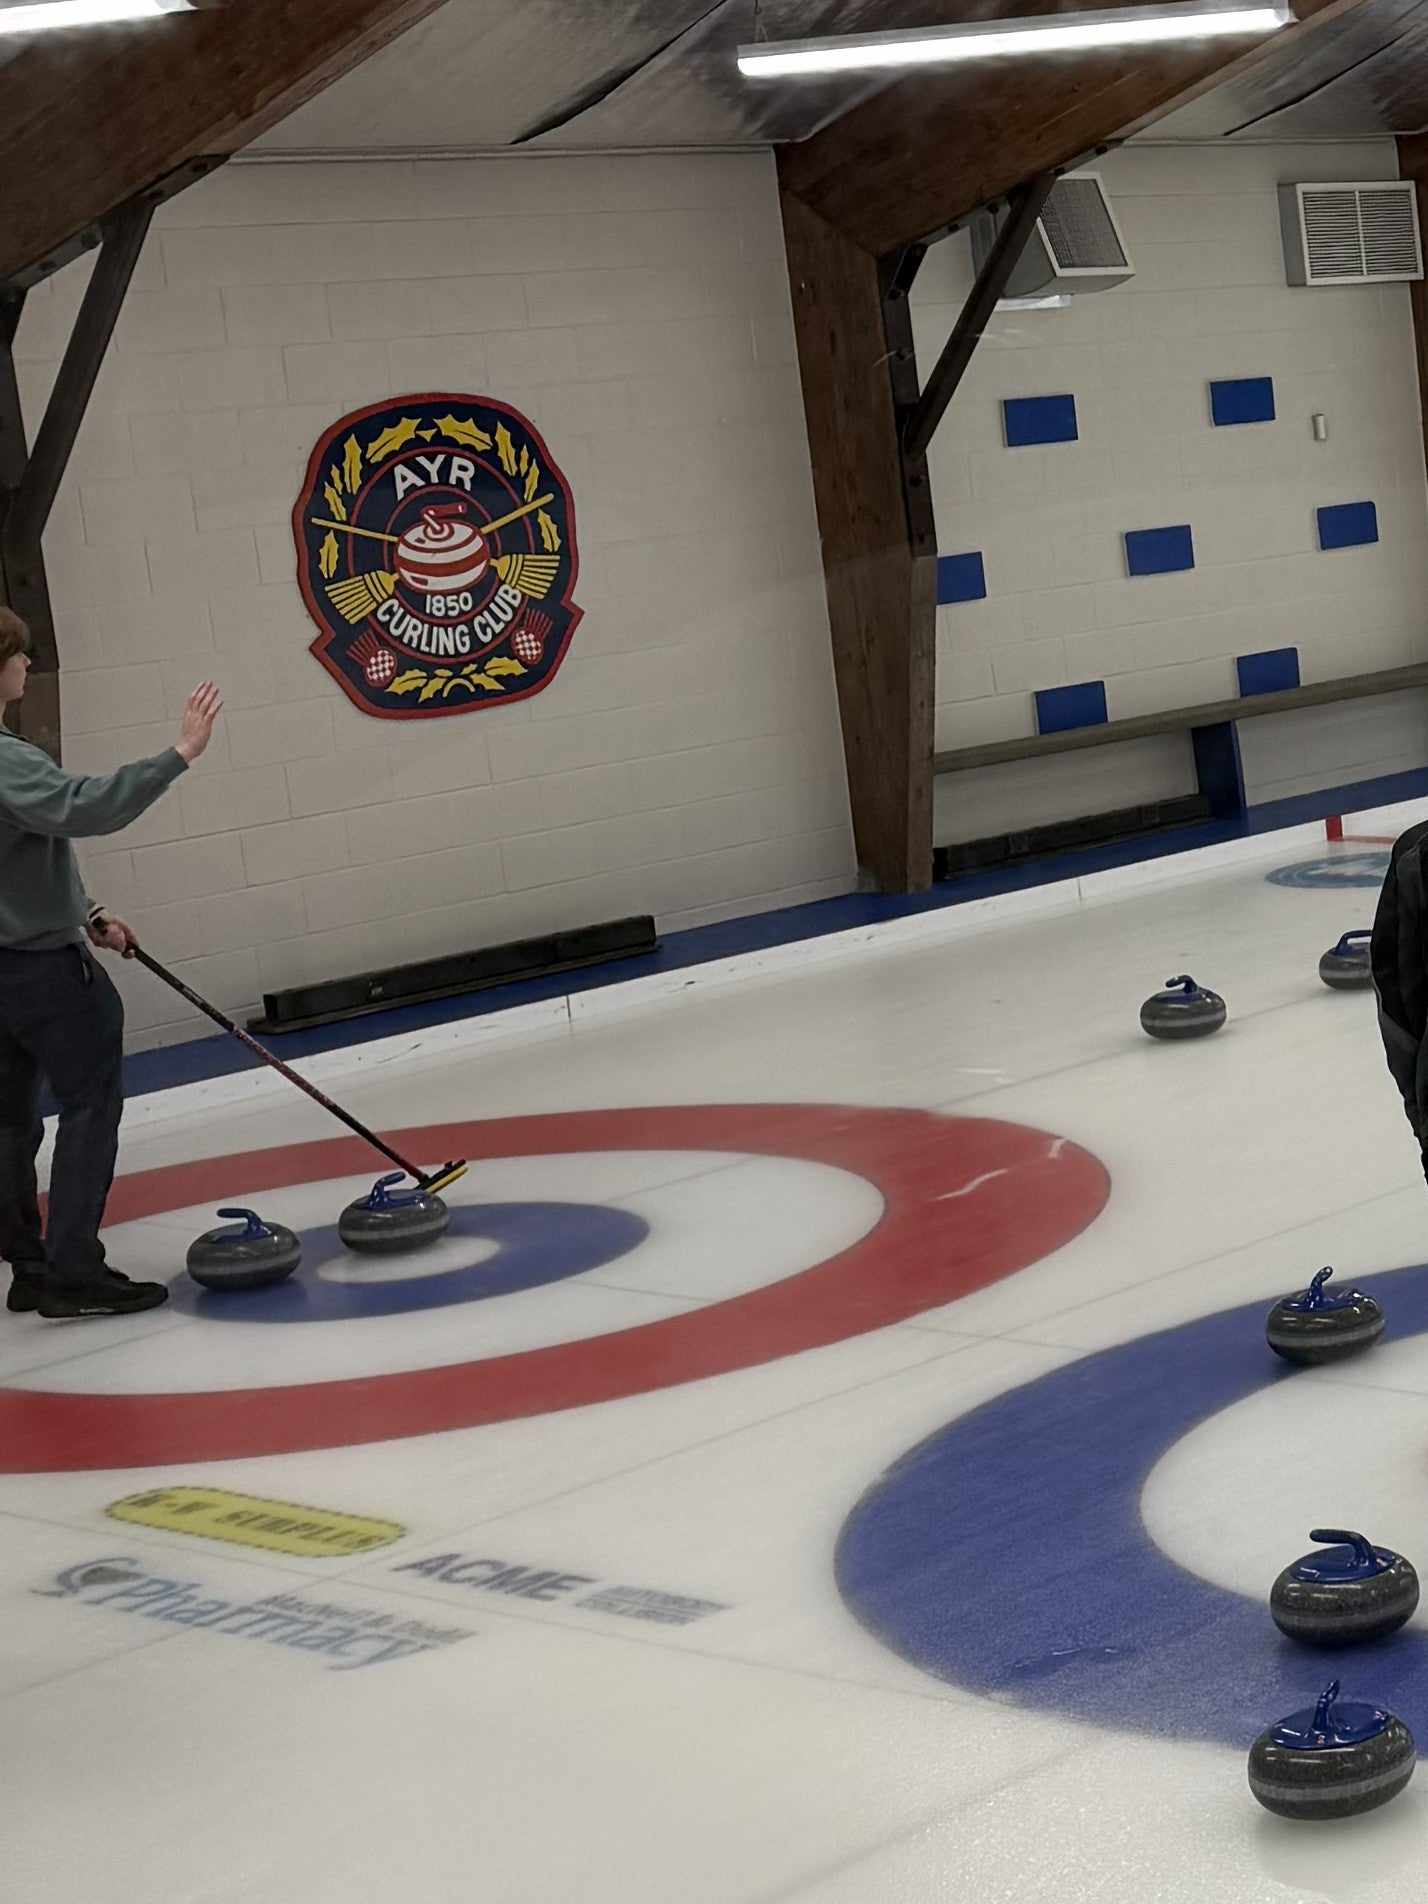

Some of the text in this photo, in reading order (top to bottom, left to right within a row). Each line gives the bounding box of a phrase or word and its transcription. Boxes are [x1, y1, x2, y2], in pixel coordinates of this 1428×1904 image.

[393, 453, 476, 502] AYR
[377, 585, 522, 656] CURLING CLUB
[425, 591, 473, 617] 1850
[391, 1553, 600, 1602] ACME
[84, 1577, 437, 1671] Pharmacy
